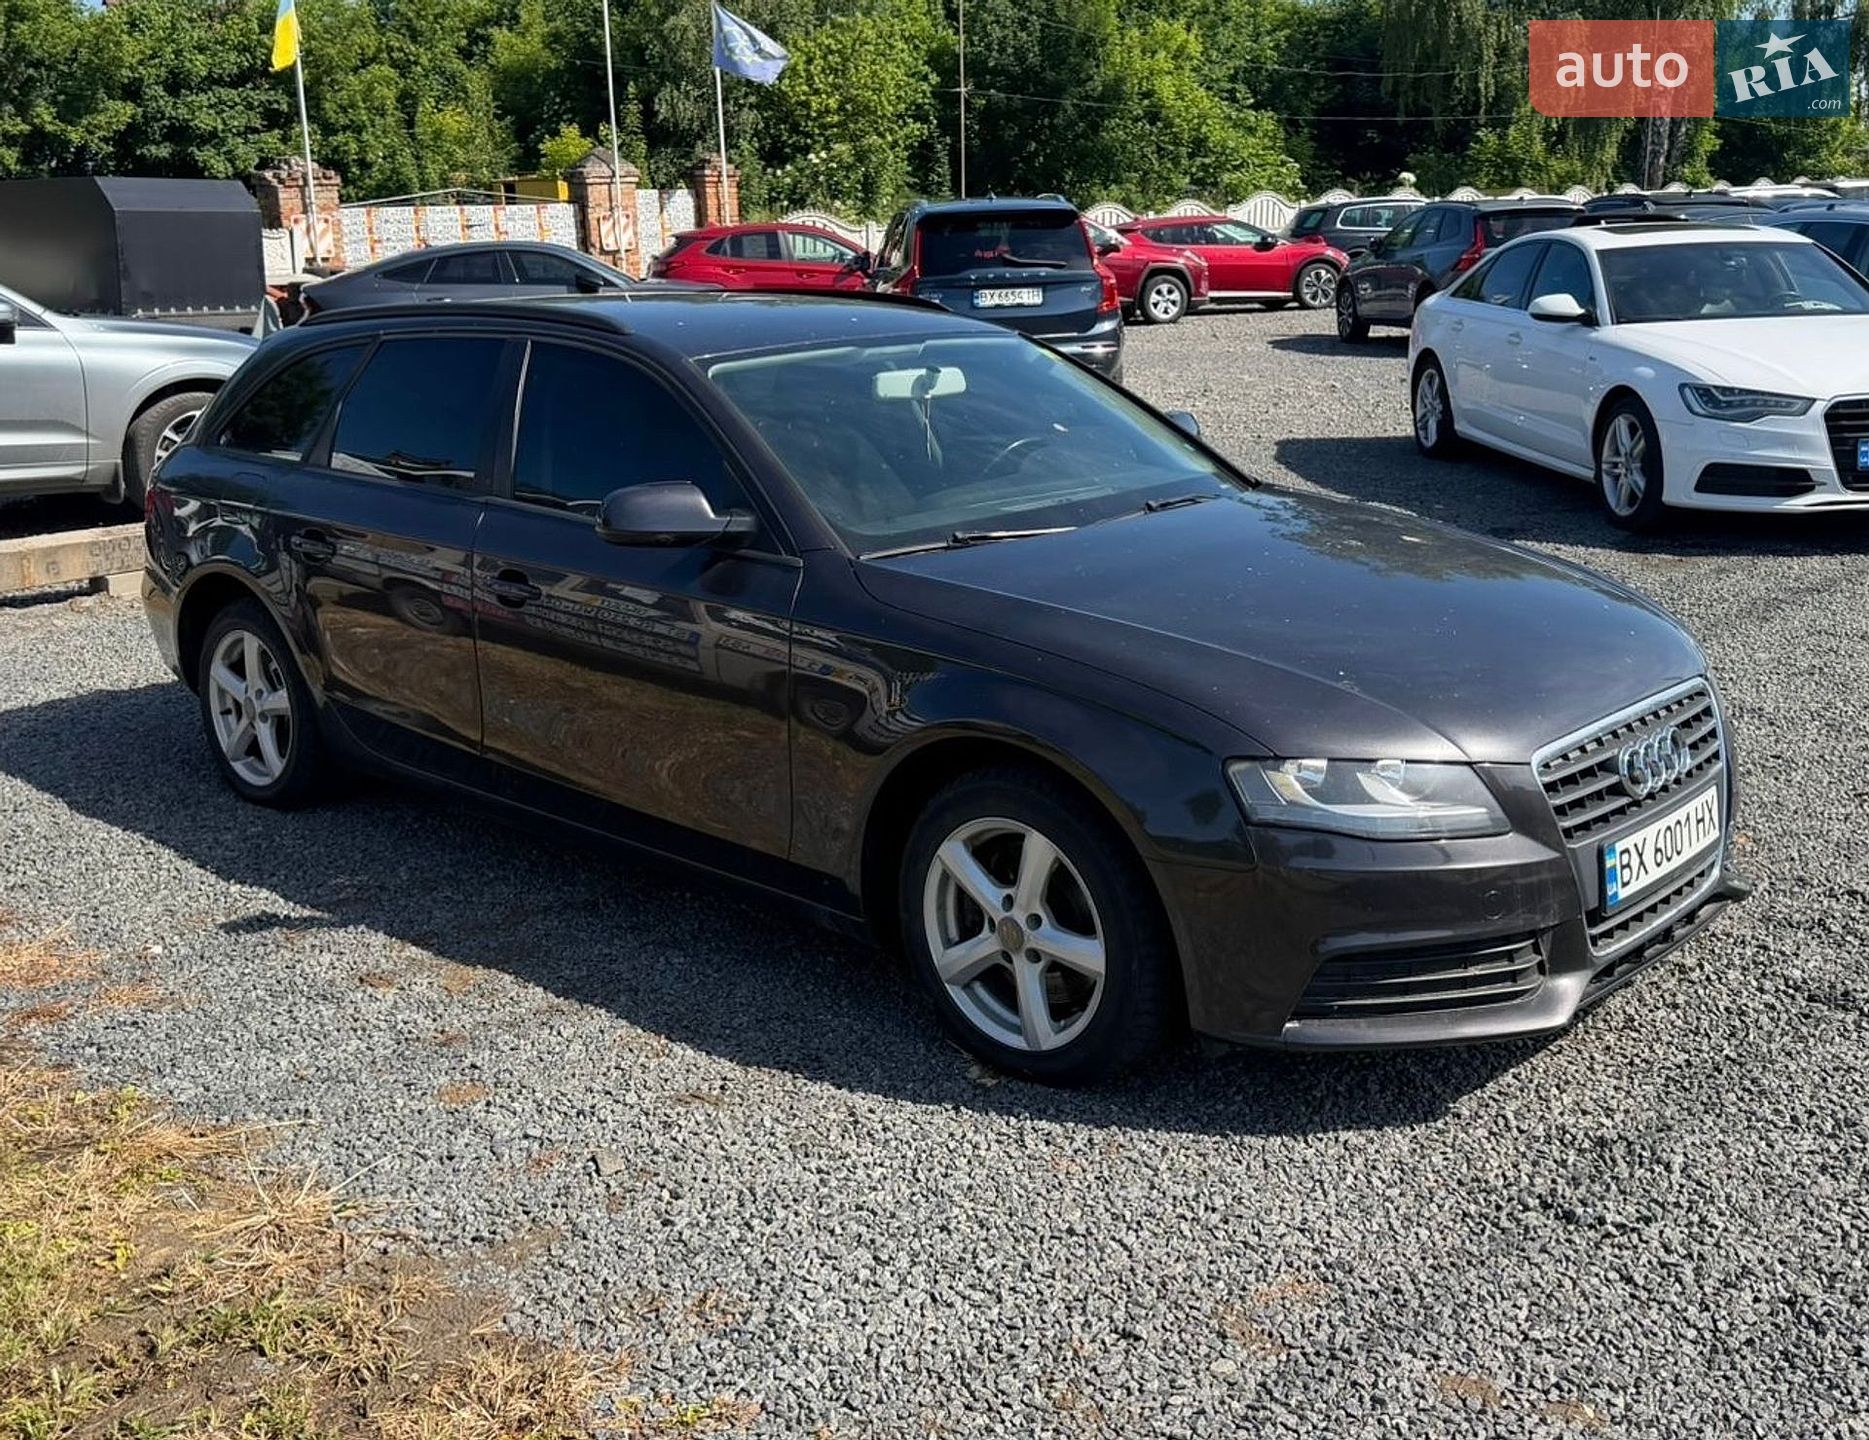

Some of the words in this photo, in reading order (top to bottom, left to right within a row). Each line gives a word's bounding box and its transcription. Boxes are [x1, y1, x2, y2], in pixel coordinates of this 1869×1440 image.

[1619, 837, 1649, 889] BX
[1653, 811, 1692, 868] 6001
[1695, 794, 1716, 843] HX
